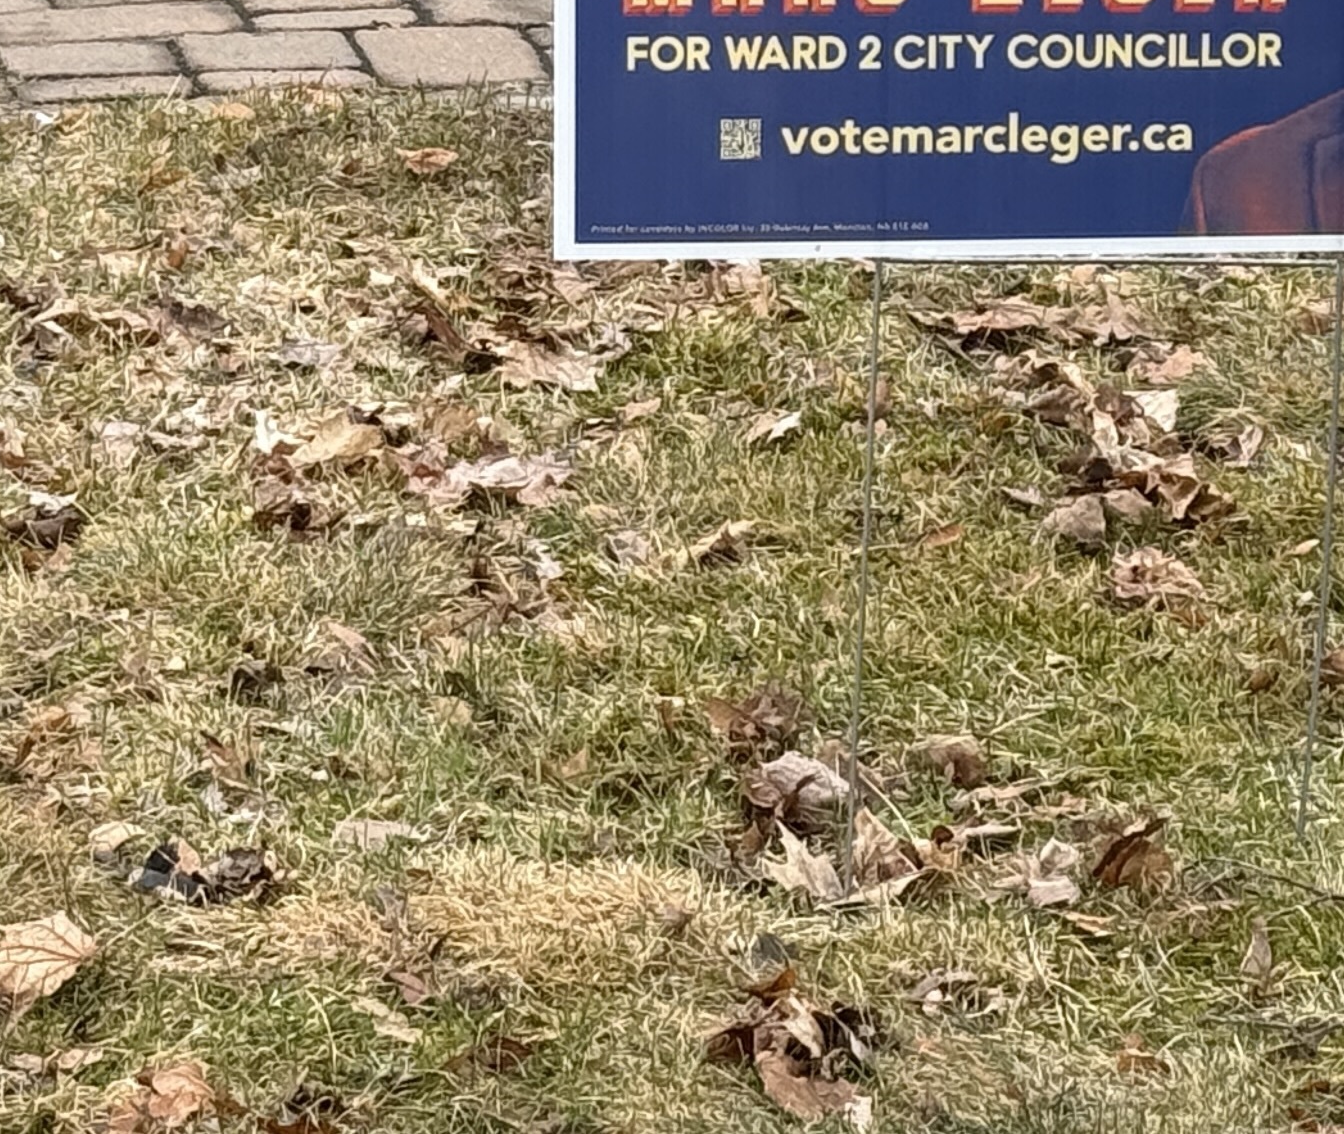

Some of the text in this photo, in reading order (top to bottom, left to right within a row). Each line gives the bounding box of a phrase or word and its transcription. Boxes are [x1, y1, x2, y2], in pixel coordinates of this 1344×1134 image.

[627, 32, 1282, 71] FOR WARD 2 CITY COUNCILLOR
[781, 112, 1193, 165] votemarcleger.ca
